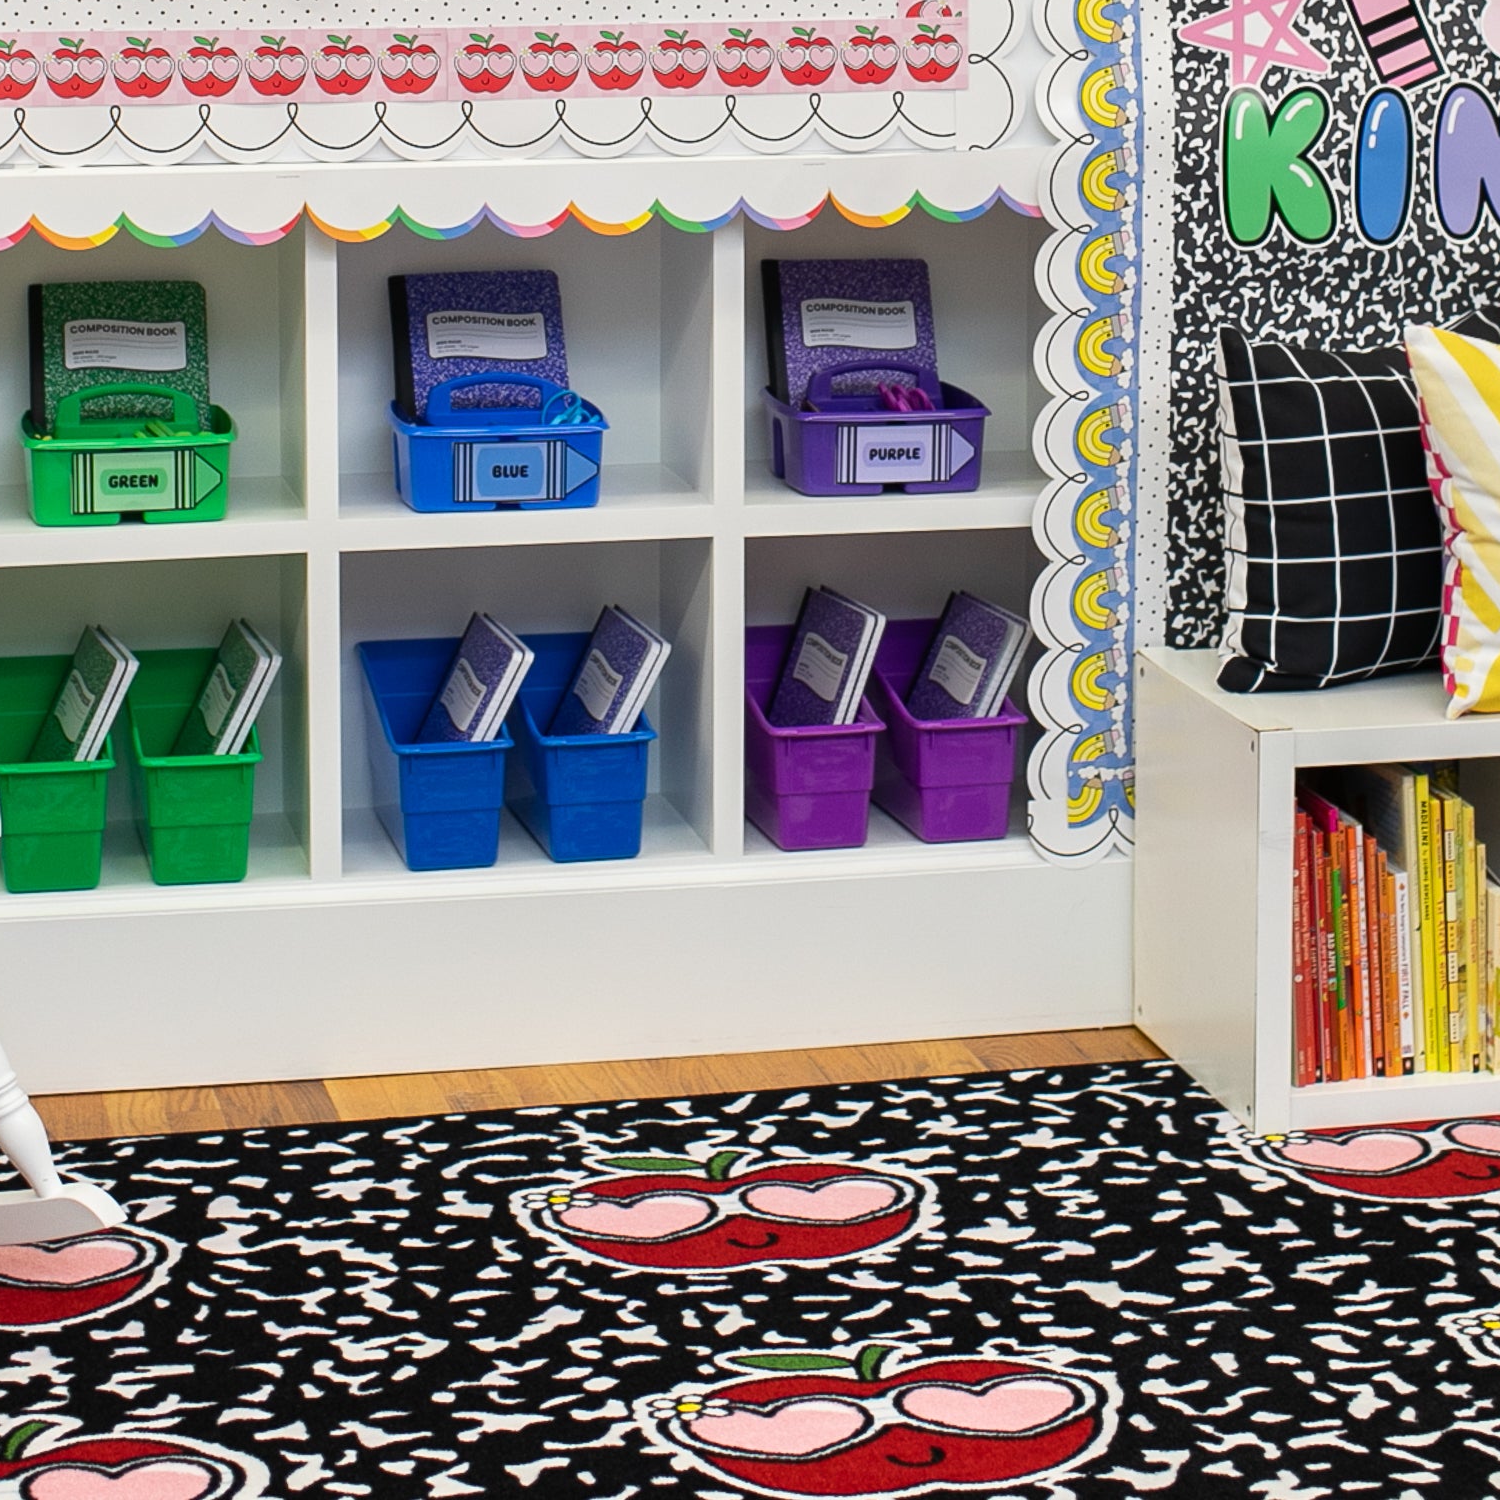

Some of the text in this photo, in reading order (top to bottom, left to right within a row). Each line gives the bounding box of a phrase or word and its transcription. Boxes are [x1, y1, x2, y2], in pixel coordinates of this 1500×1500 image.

[806, 303, 906, 316] COMPOSITION BOOK
[432, 315, 536, 327] COMPOSITION BOOK
[70, 324, 177, 337] COMPOSITION BOOK
[869, 447, 921, 461] PURPLE
[492, 465, 529, 478] BLUE
[108, 474, 158, 488] GREEN
